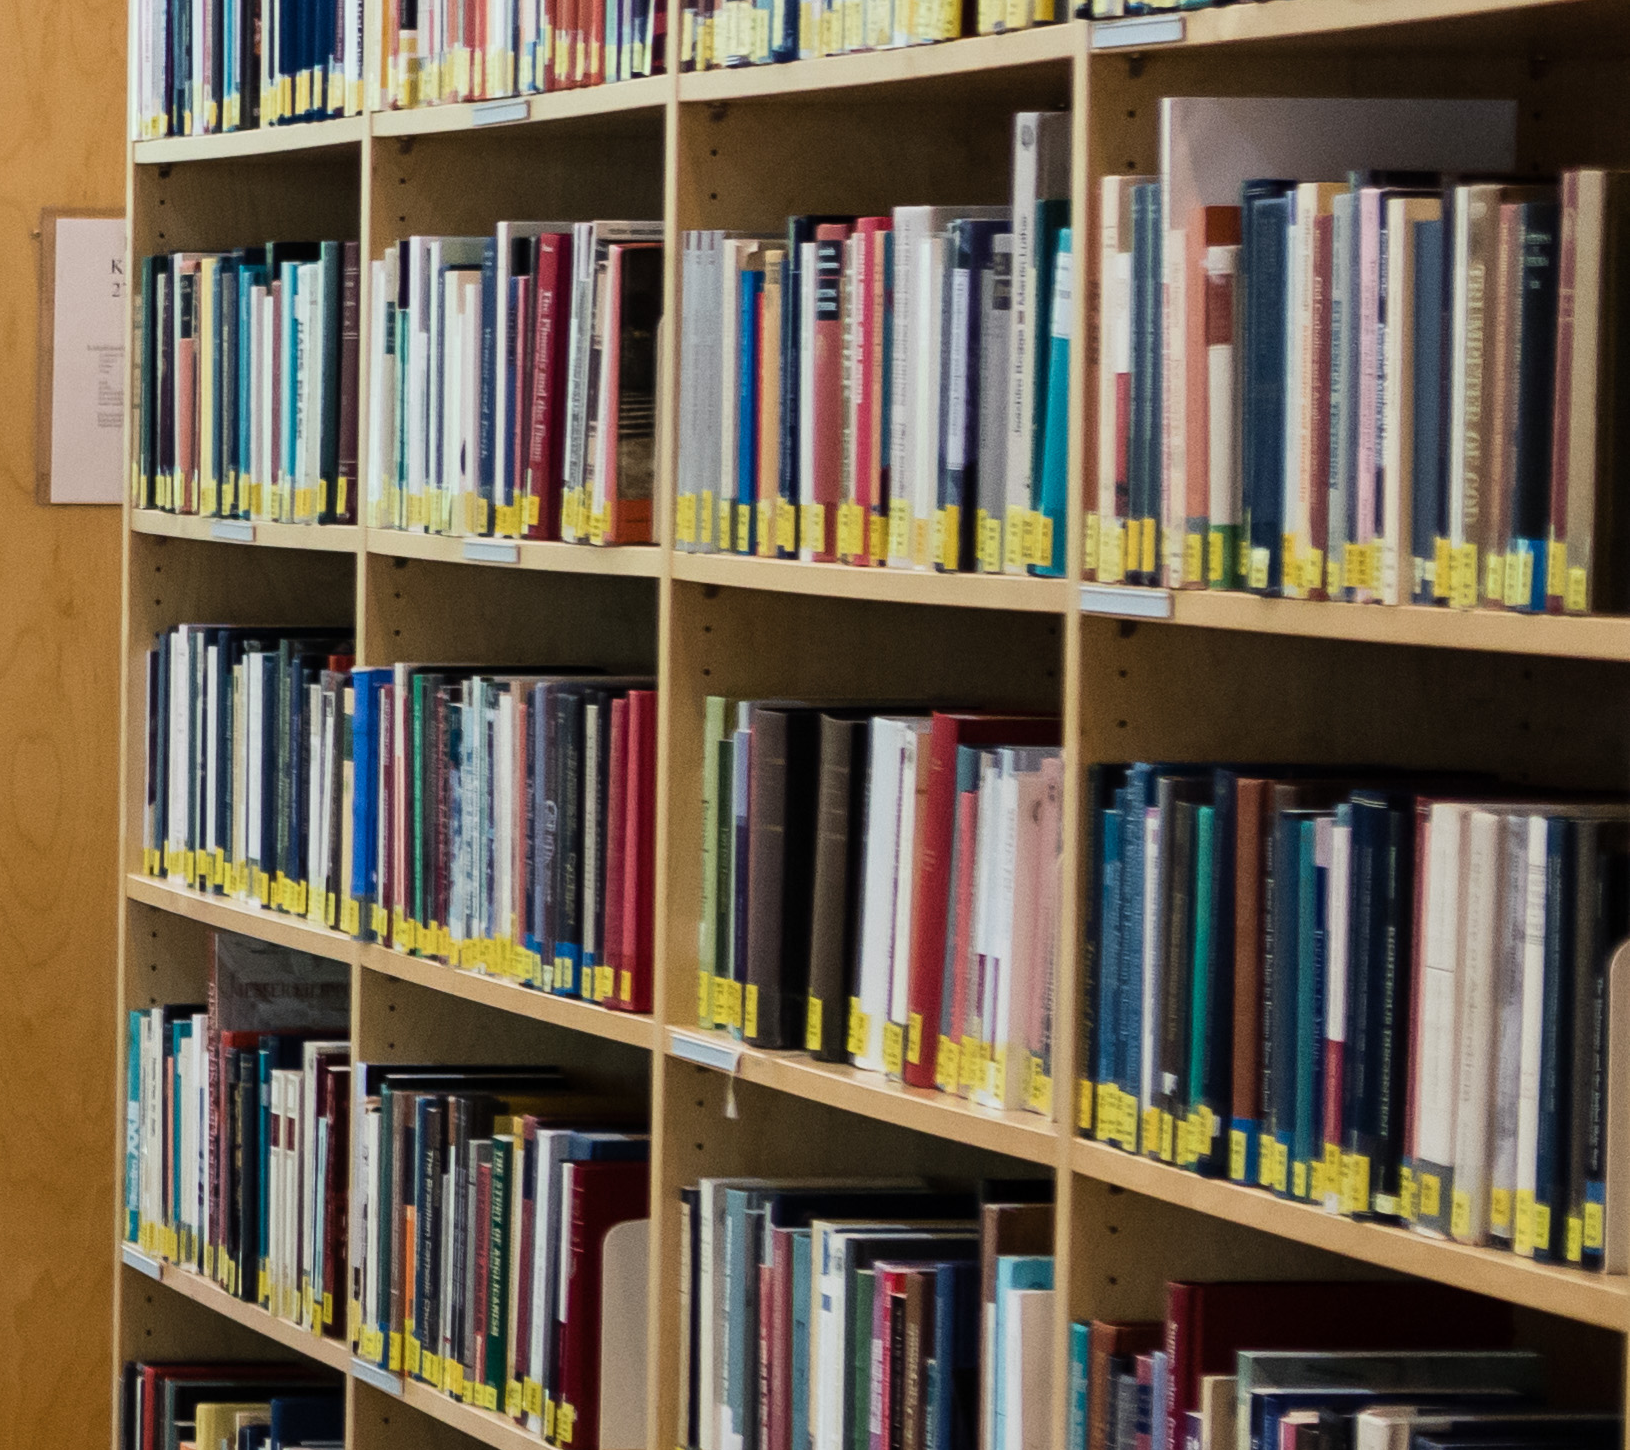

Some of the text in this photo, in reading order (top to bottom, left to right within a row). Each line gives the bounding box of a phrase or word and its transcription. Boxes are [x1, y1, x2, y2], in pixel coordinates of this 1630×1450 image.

[538, 291, 553, 316] The
[536, 374, 549, 398] and
[535, 400, 548, 422] the
[494, 1150, 504, 1174] THE
[492, 1179, 504, 1223] STUDY
[490, 1247, 502, 1337] ANGLICANISM
